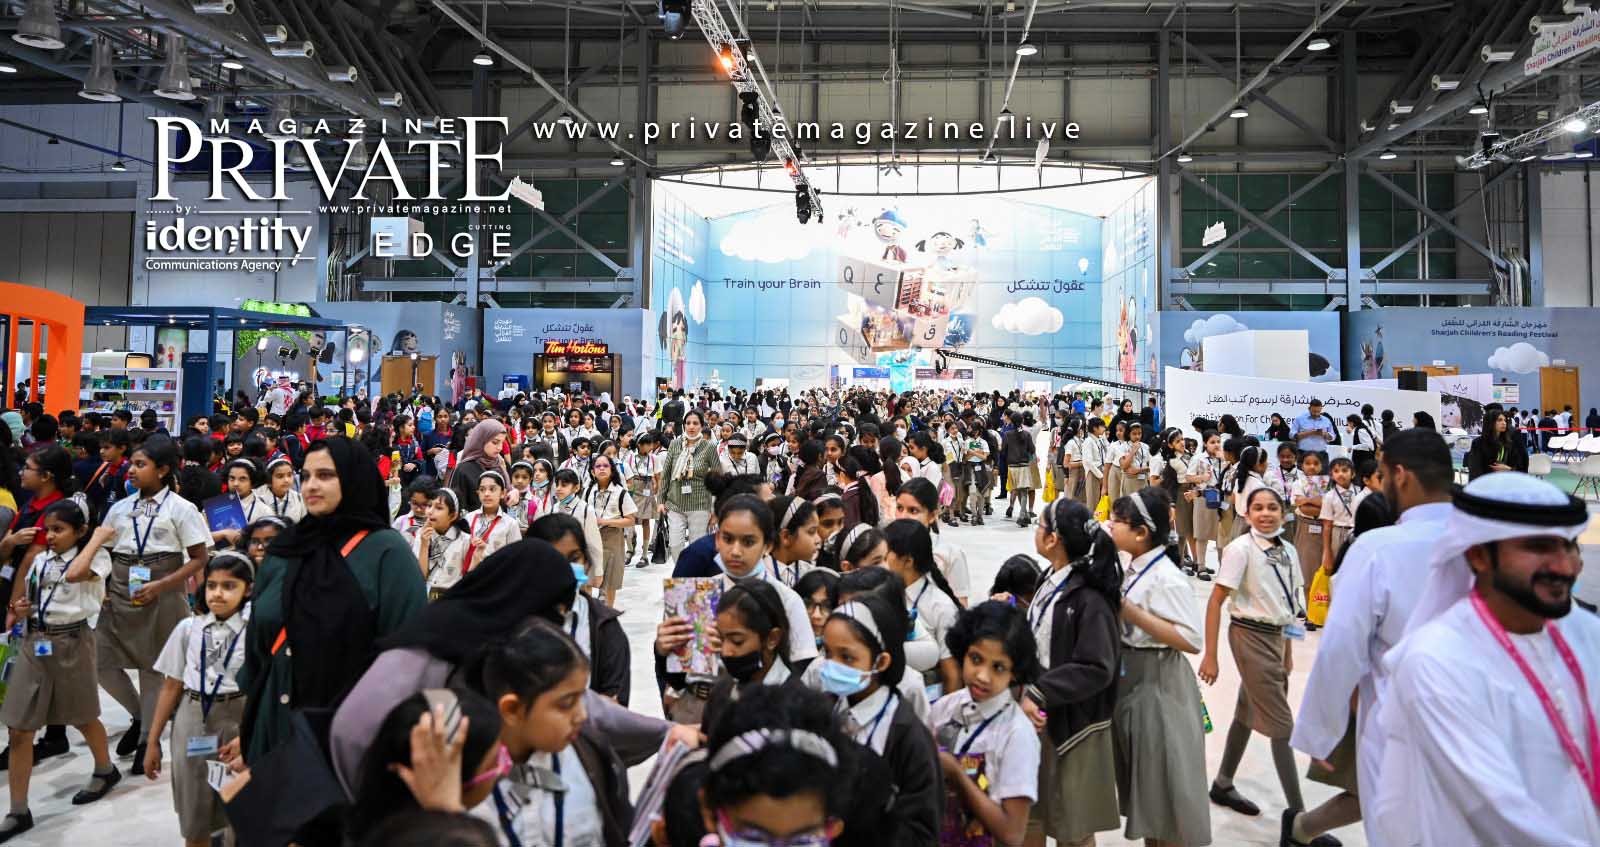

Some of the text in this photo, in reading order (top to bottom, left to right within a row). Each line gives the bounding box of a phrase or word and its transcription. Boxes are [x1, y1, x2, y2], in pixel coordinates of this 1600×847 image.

[723, 277, 821, 292] Train your Brain
[1431, 329, 1458, 337] Sharjah
[1497, 330, 1528, 339] Reading
[545, 338, 606, 354] Tim Hortons
[1245, 414, 1259, 424] For
